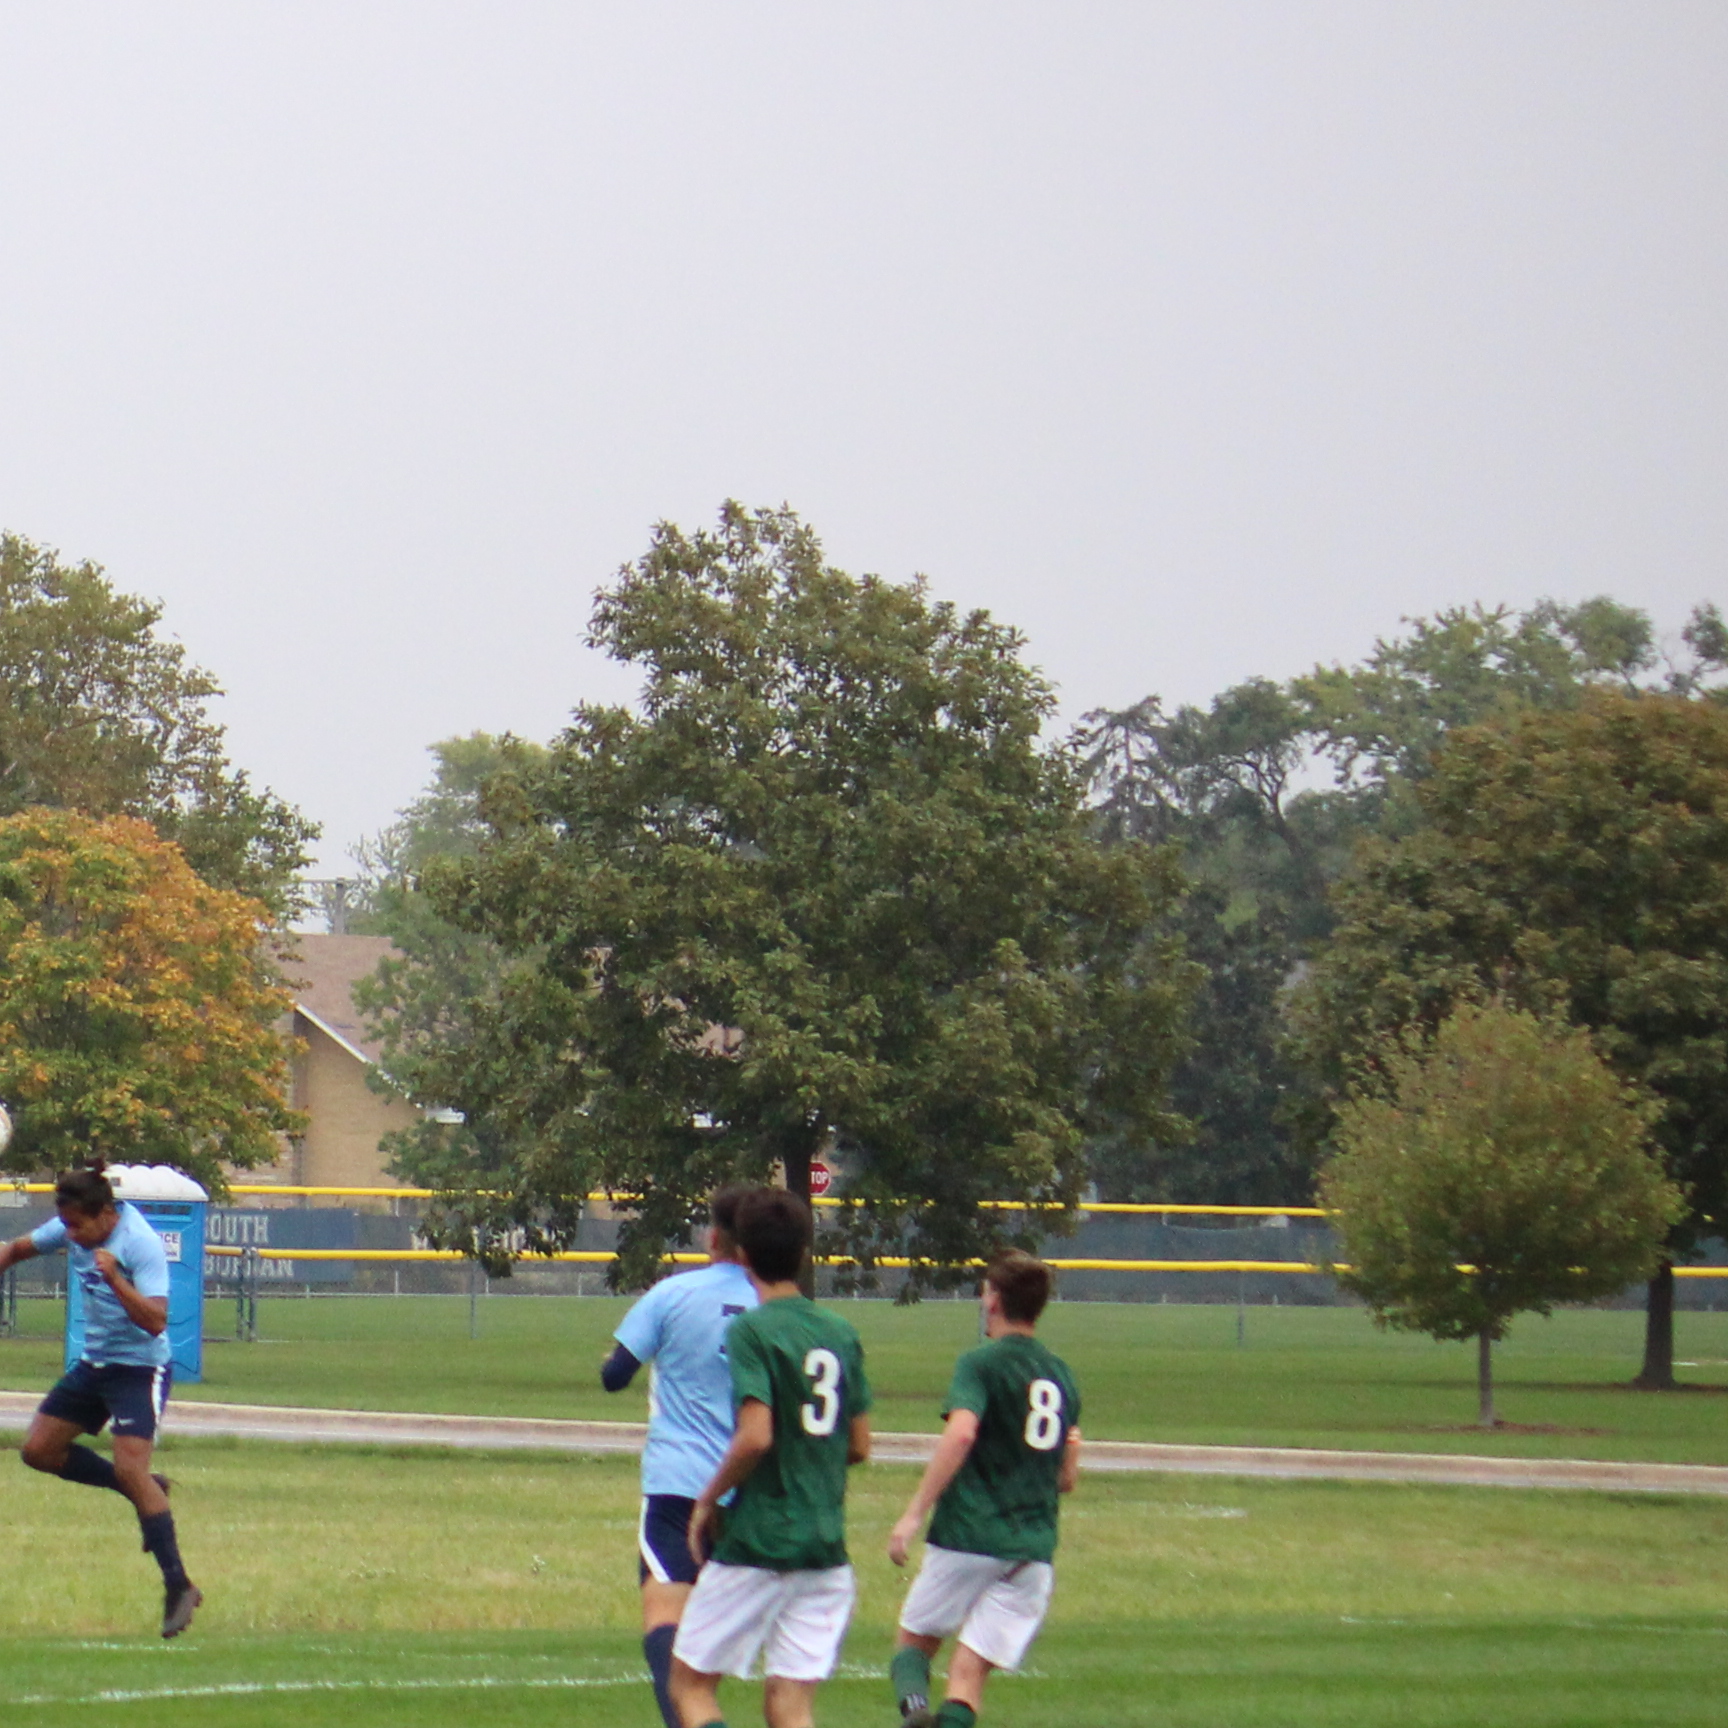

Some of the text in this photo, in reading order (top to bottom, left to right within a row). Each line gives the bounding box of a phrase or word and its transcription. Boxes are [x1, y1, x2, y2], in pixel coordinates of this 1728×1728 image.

[810, 1171, 829, 1184] TOP
[205, 1213, 269, 1244] OUTH
[801, 1348, 841, 1436] 3
[1024, 1379, 1062, 1450] 8
